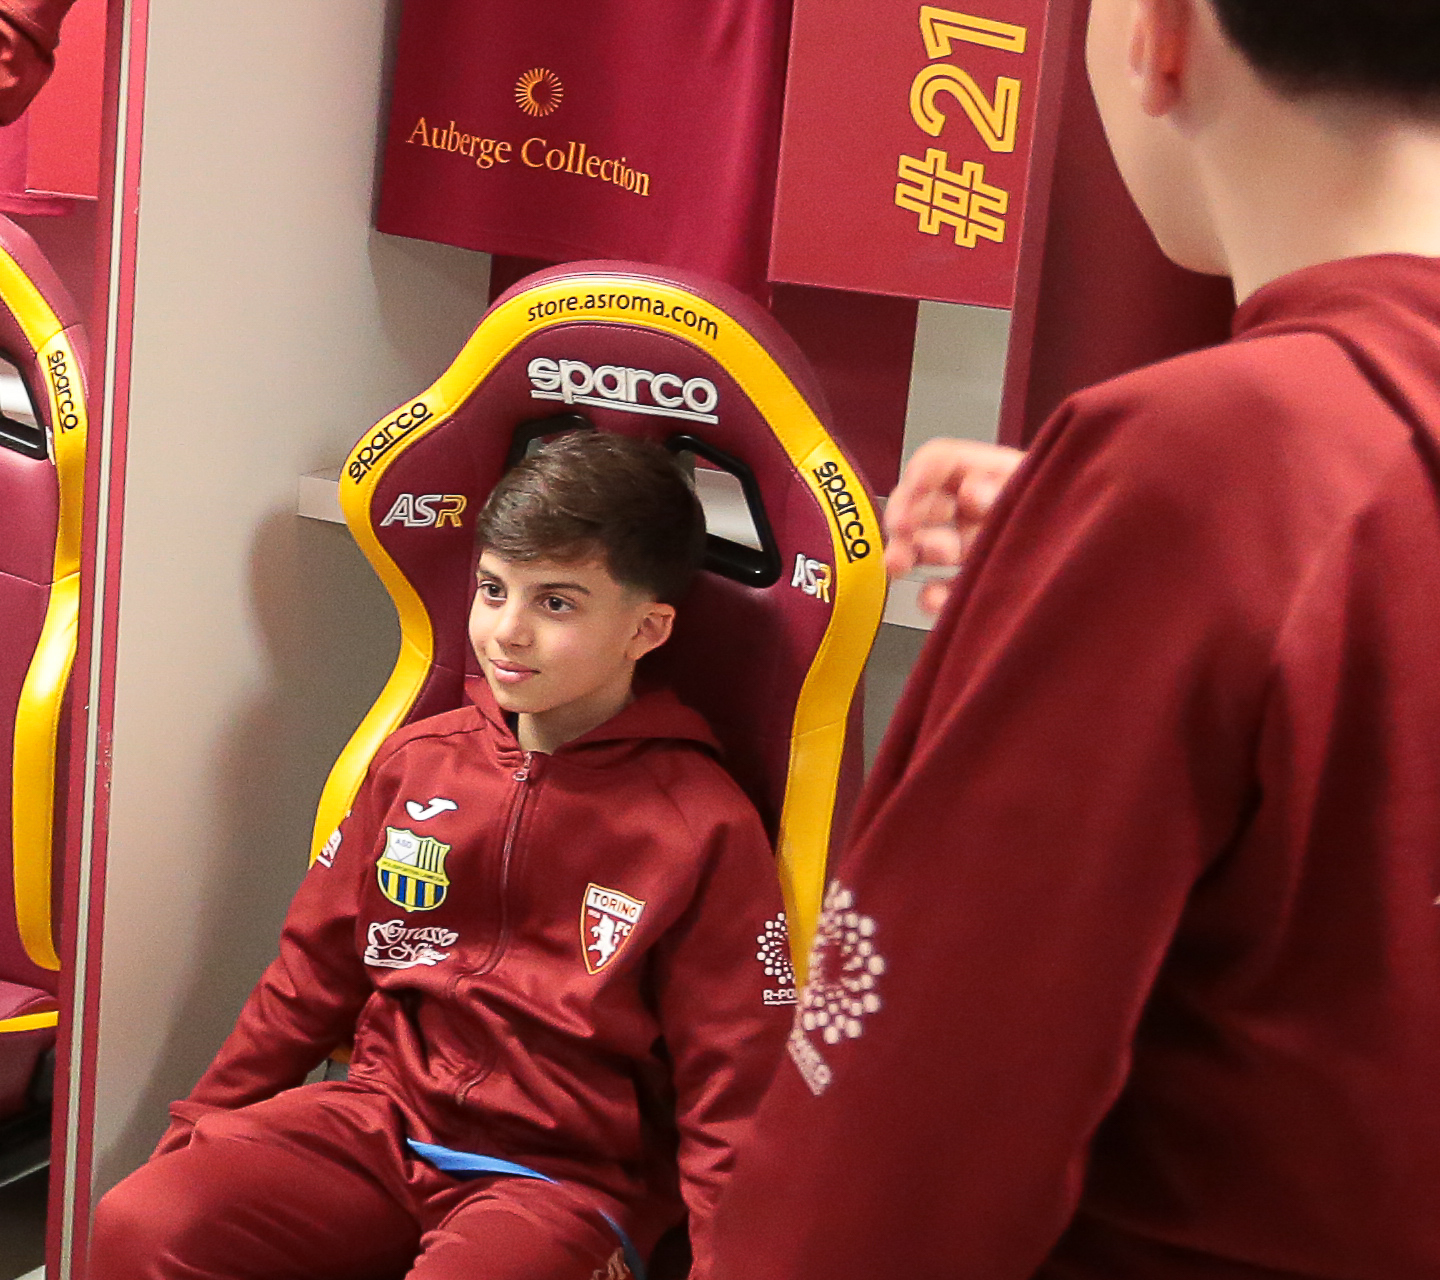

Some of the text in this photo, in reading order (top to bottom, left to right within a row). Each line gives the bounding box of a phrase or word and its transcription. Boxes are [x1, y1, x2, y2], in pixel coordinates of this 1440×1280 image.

[894, 5, 1028, 249] #21
[406, 116, 651, 197] Auberge Collection
[527, 293, 720, 340] store.asroma.com
[48, 349, 78, 432] sparco
[528, 357, 719, 412] sparco
[347, 401, 429, 480] sparco
[380, 493, 469, 529] ASR
[815, 460, 871, 561] sparco
[791, 553, 832, 604] ASR
[593, 891, 638, 918] TORINO
[614, 921, 631, 937] FC
